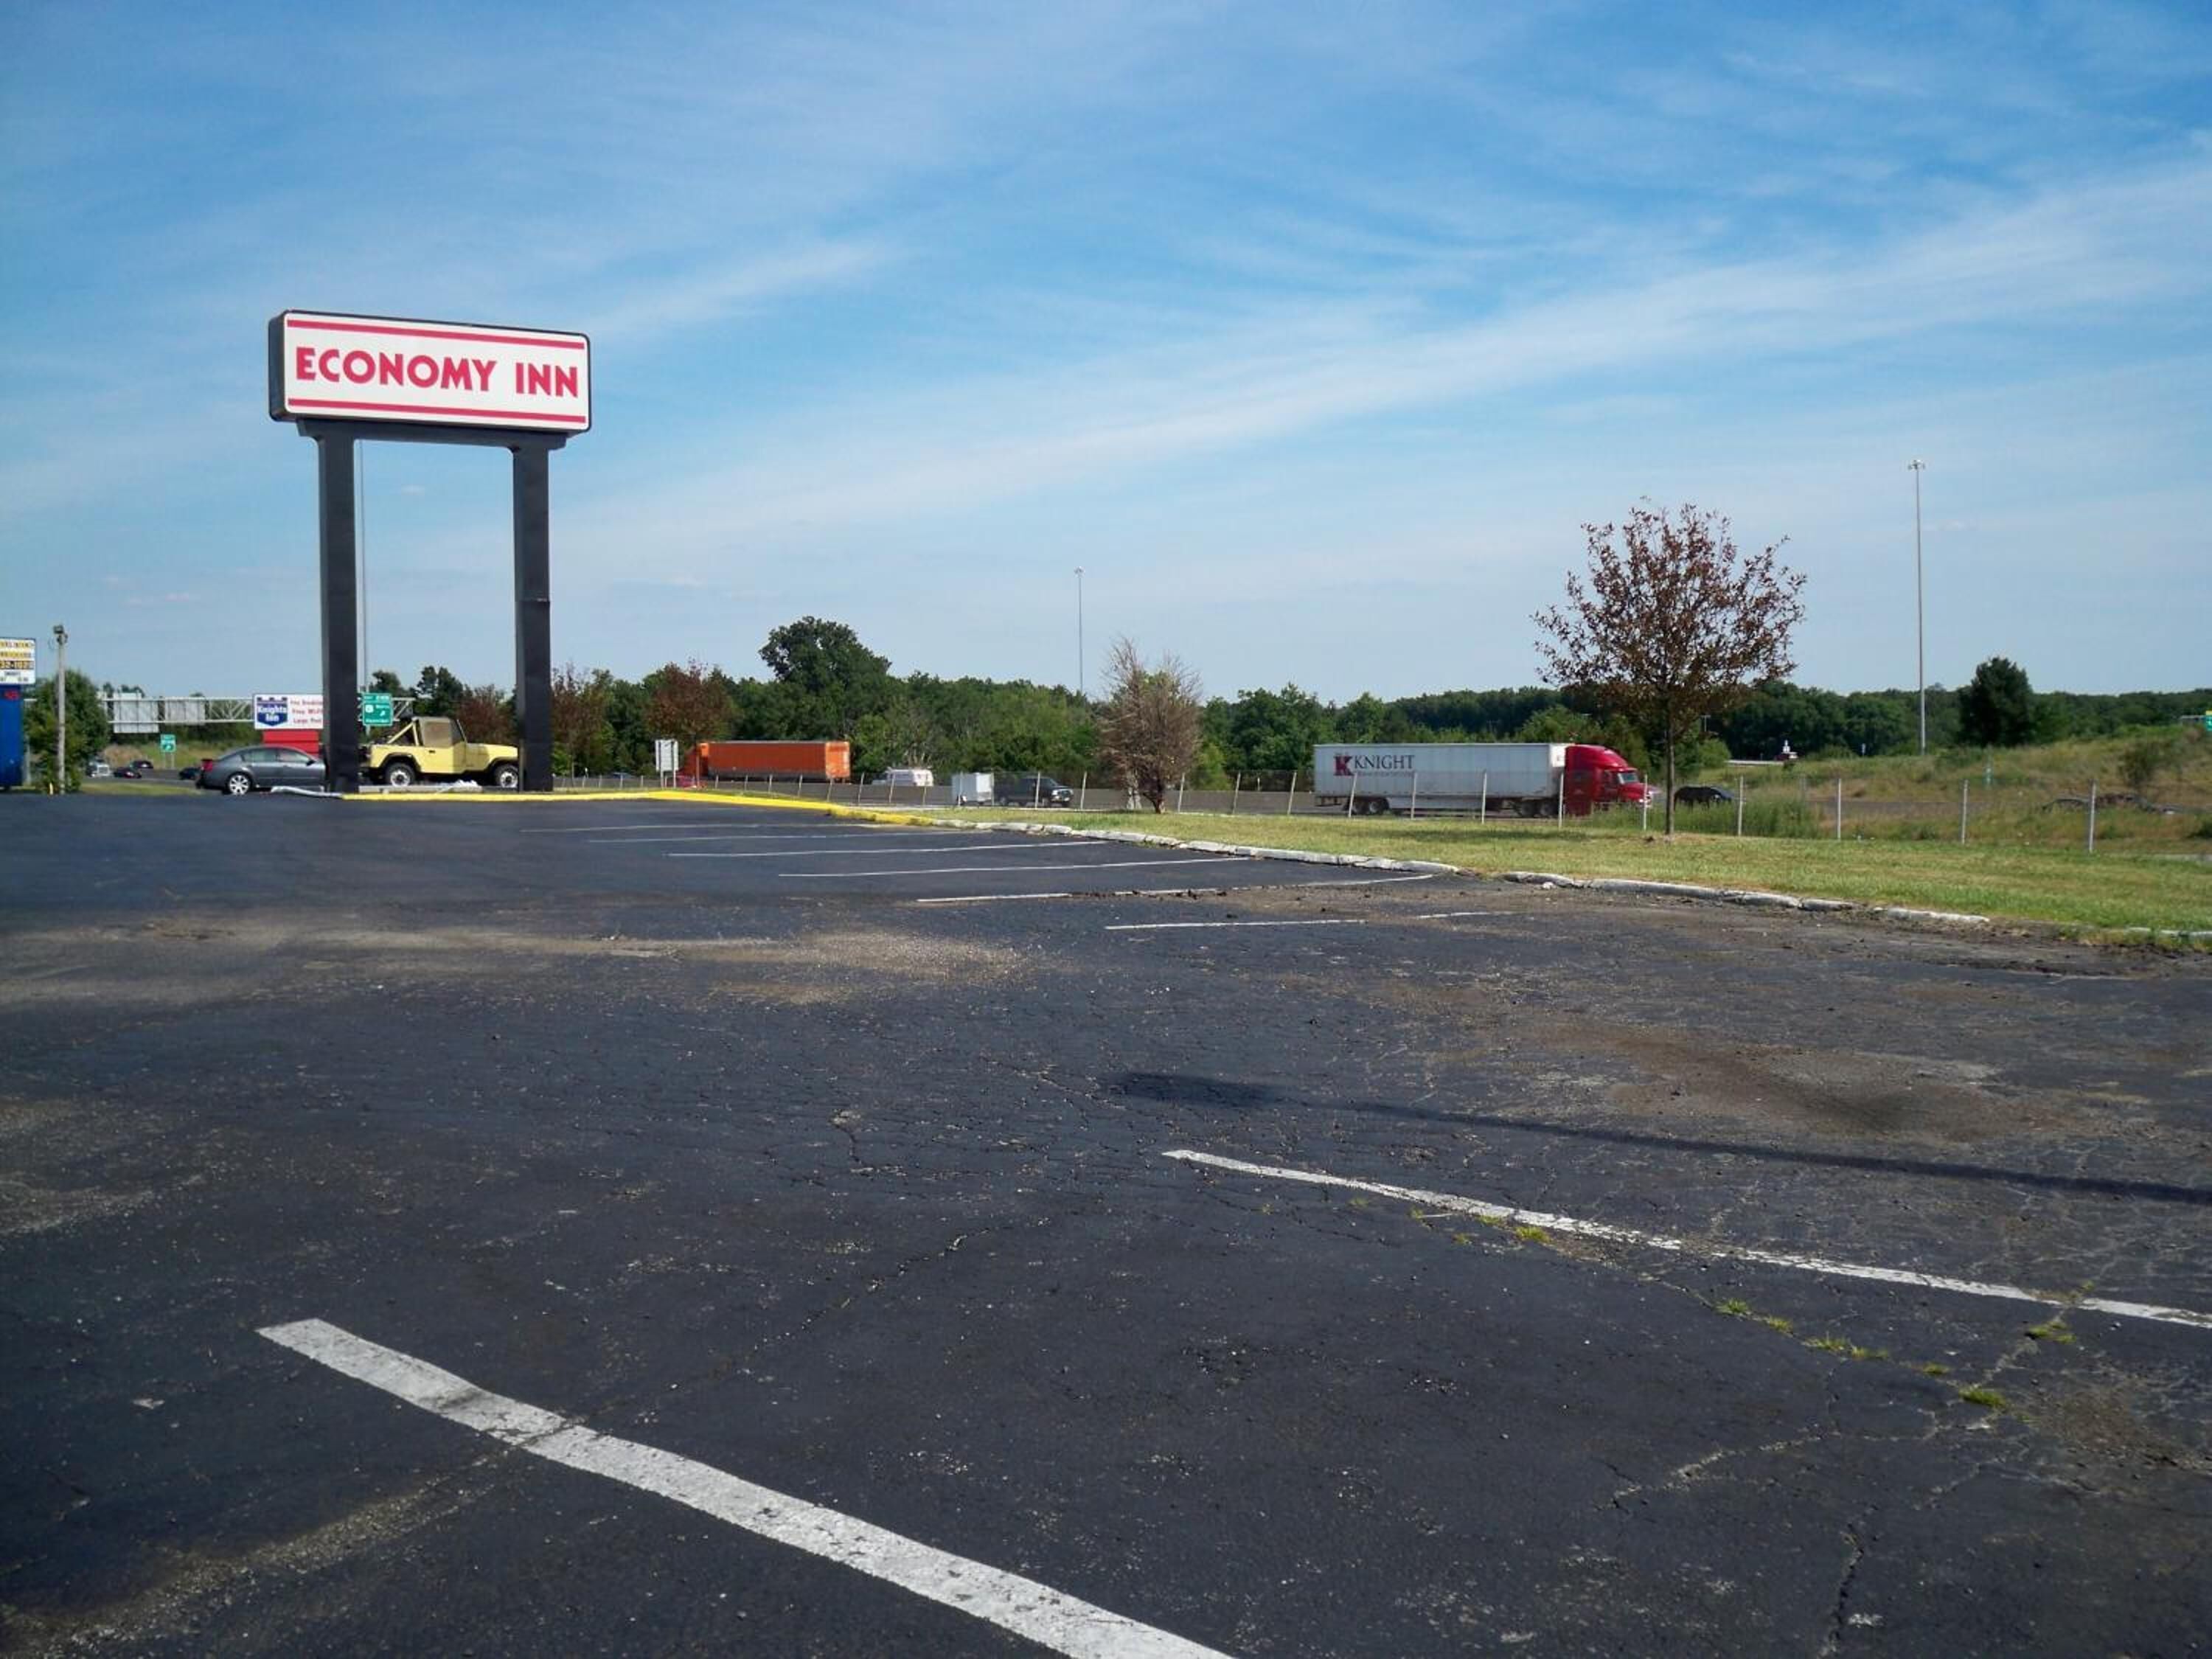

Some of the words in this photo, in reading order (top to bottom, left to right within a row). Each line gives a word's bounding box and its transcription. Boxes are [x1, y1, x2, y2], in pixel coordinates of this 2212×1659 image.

[296, 347, 496, 391] ECONOMY
[516, 362, 578, 398] INN
[265, 713, 279, 722] Inn
[1354, 754, 1415, 769] KNIGHT
